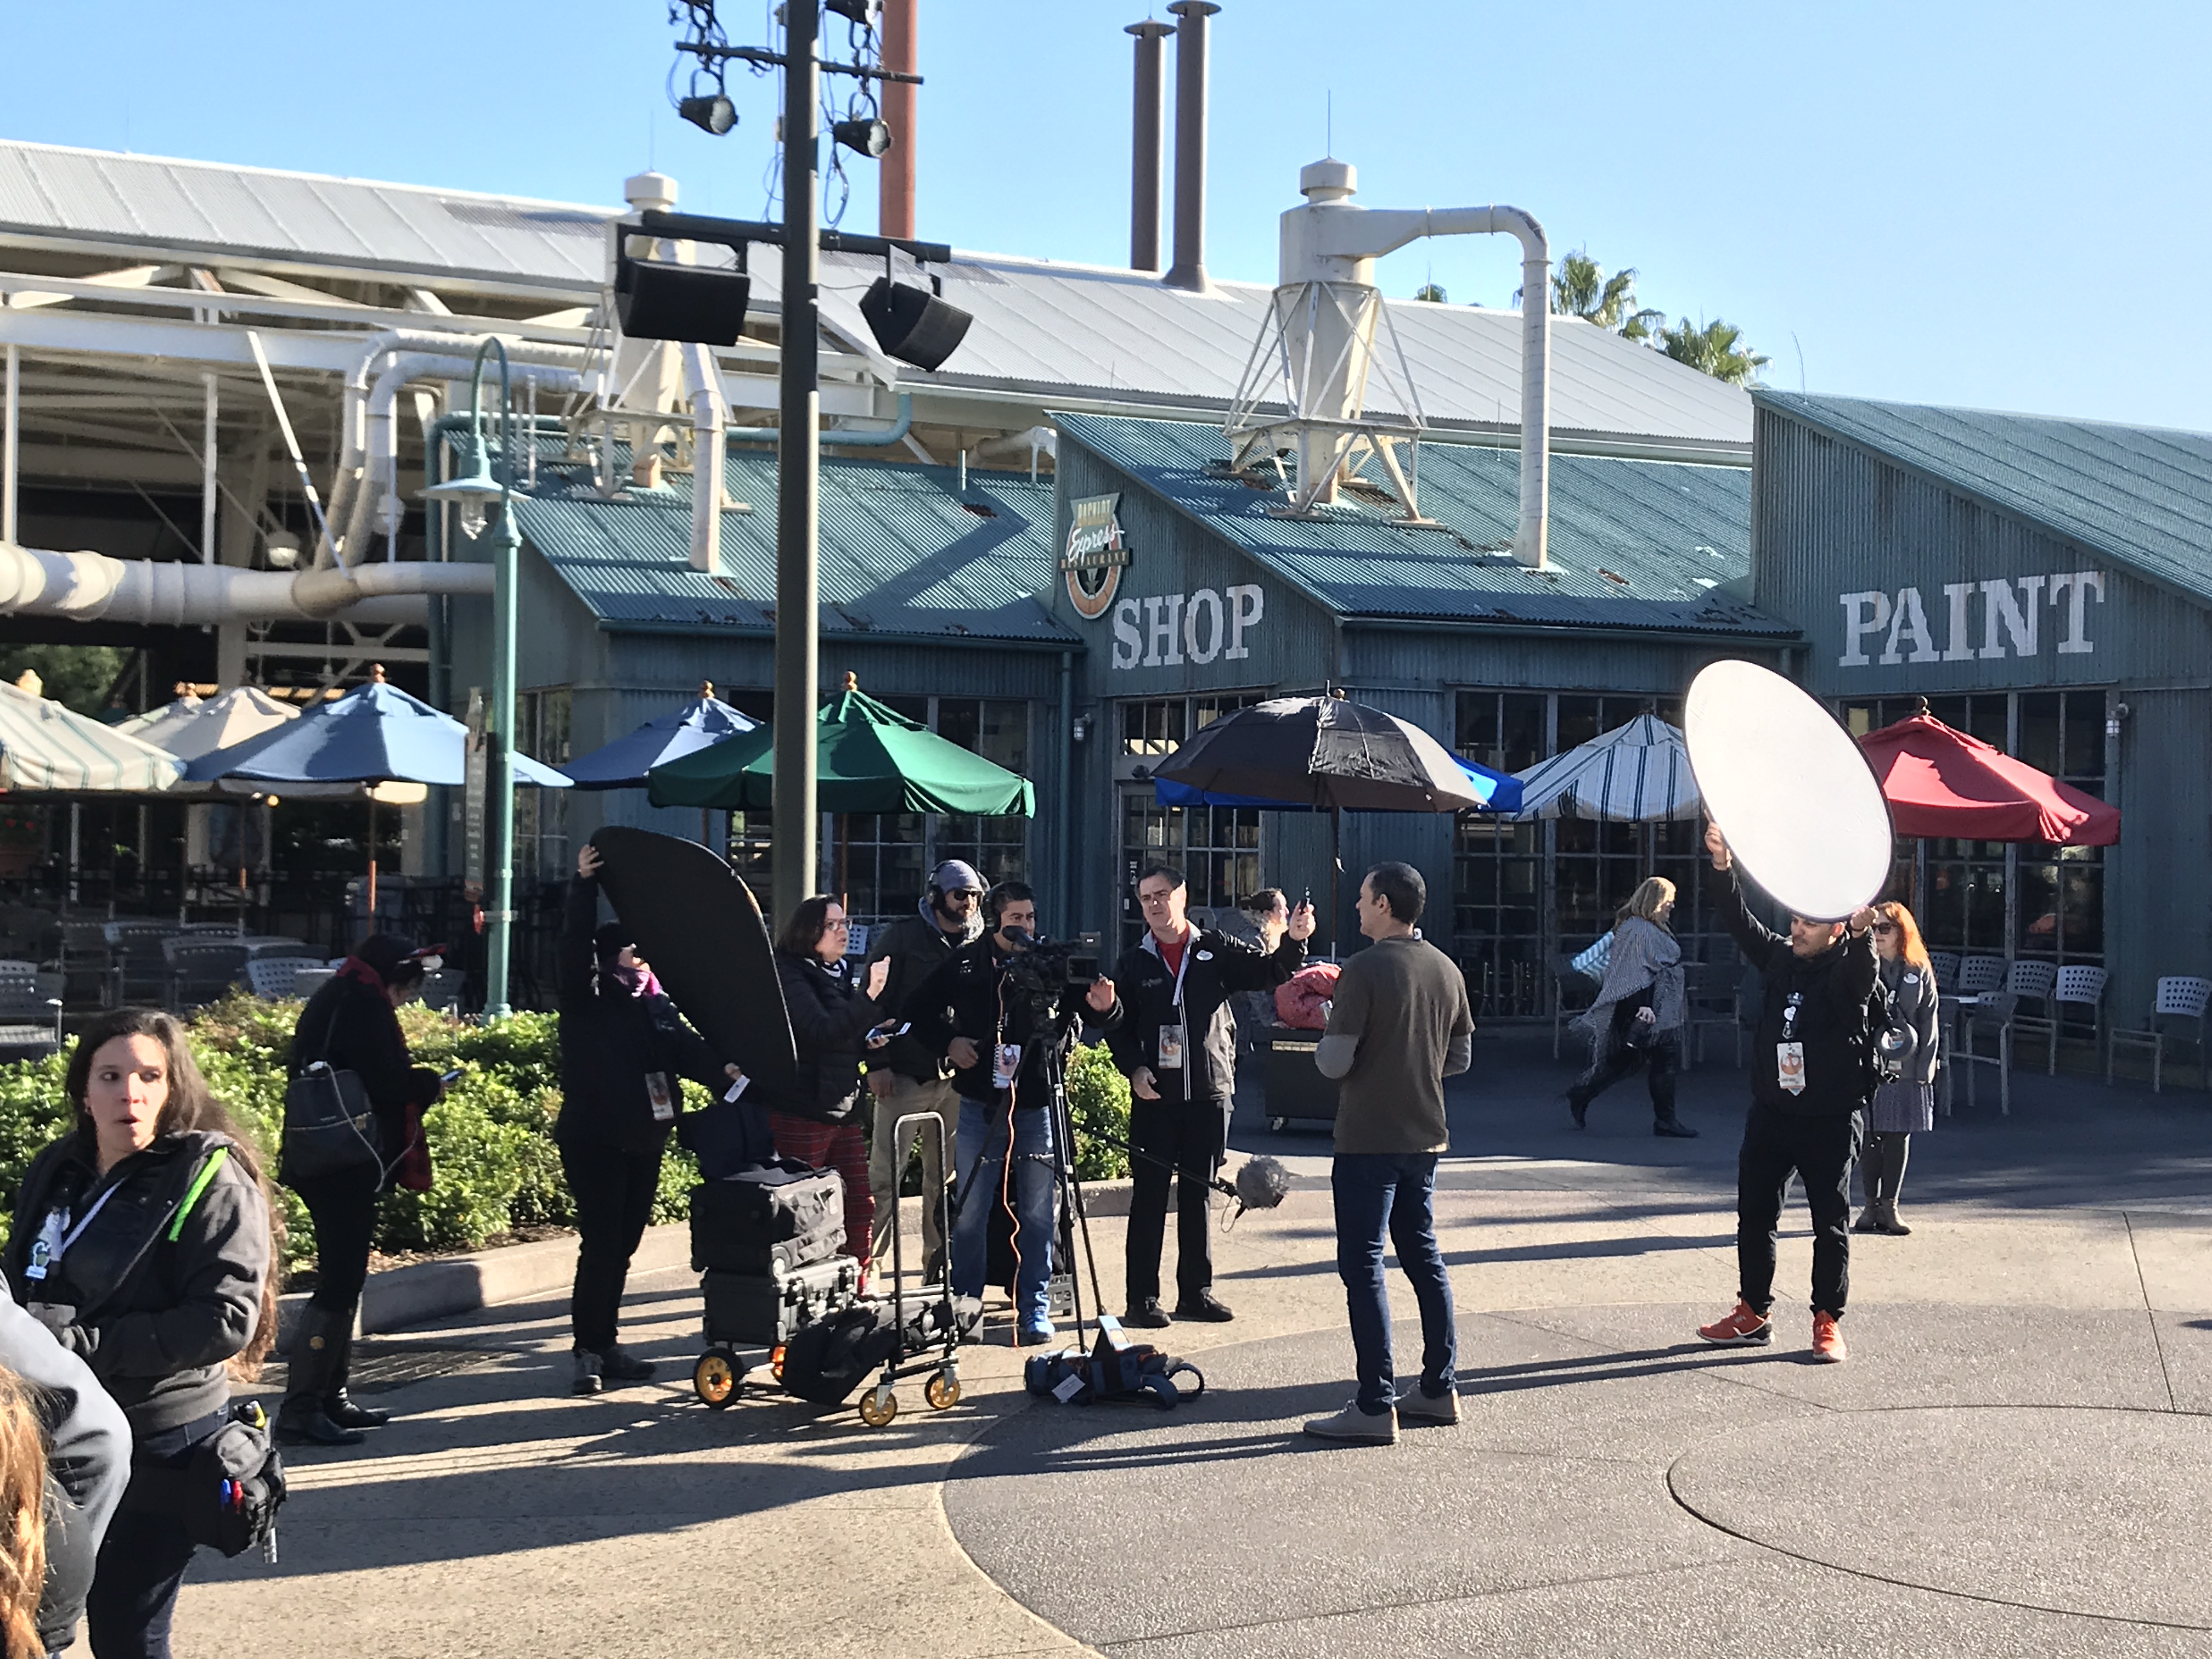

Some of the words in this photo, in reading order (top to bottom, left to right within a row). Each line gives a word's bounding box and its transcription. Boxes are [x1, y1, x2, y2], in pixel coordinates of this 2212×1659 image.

[1061, 551, 1126, 569] RESAURANT
[1068, 523, 1125, 566] Express
[1112, 584, 1263, 669] SHOP
[1838, 571, 2105, 666] PAINT
